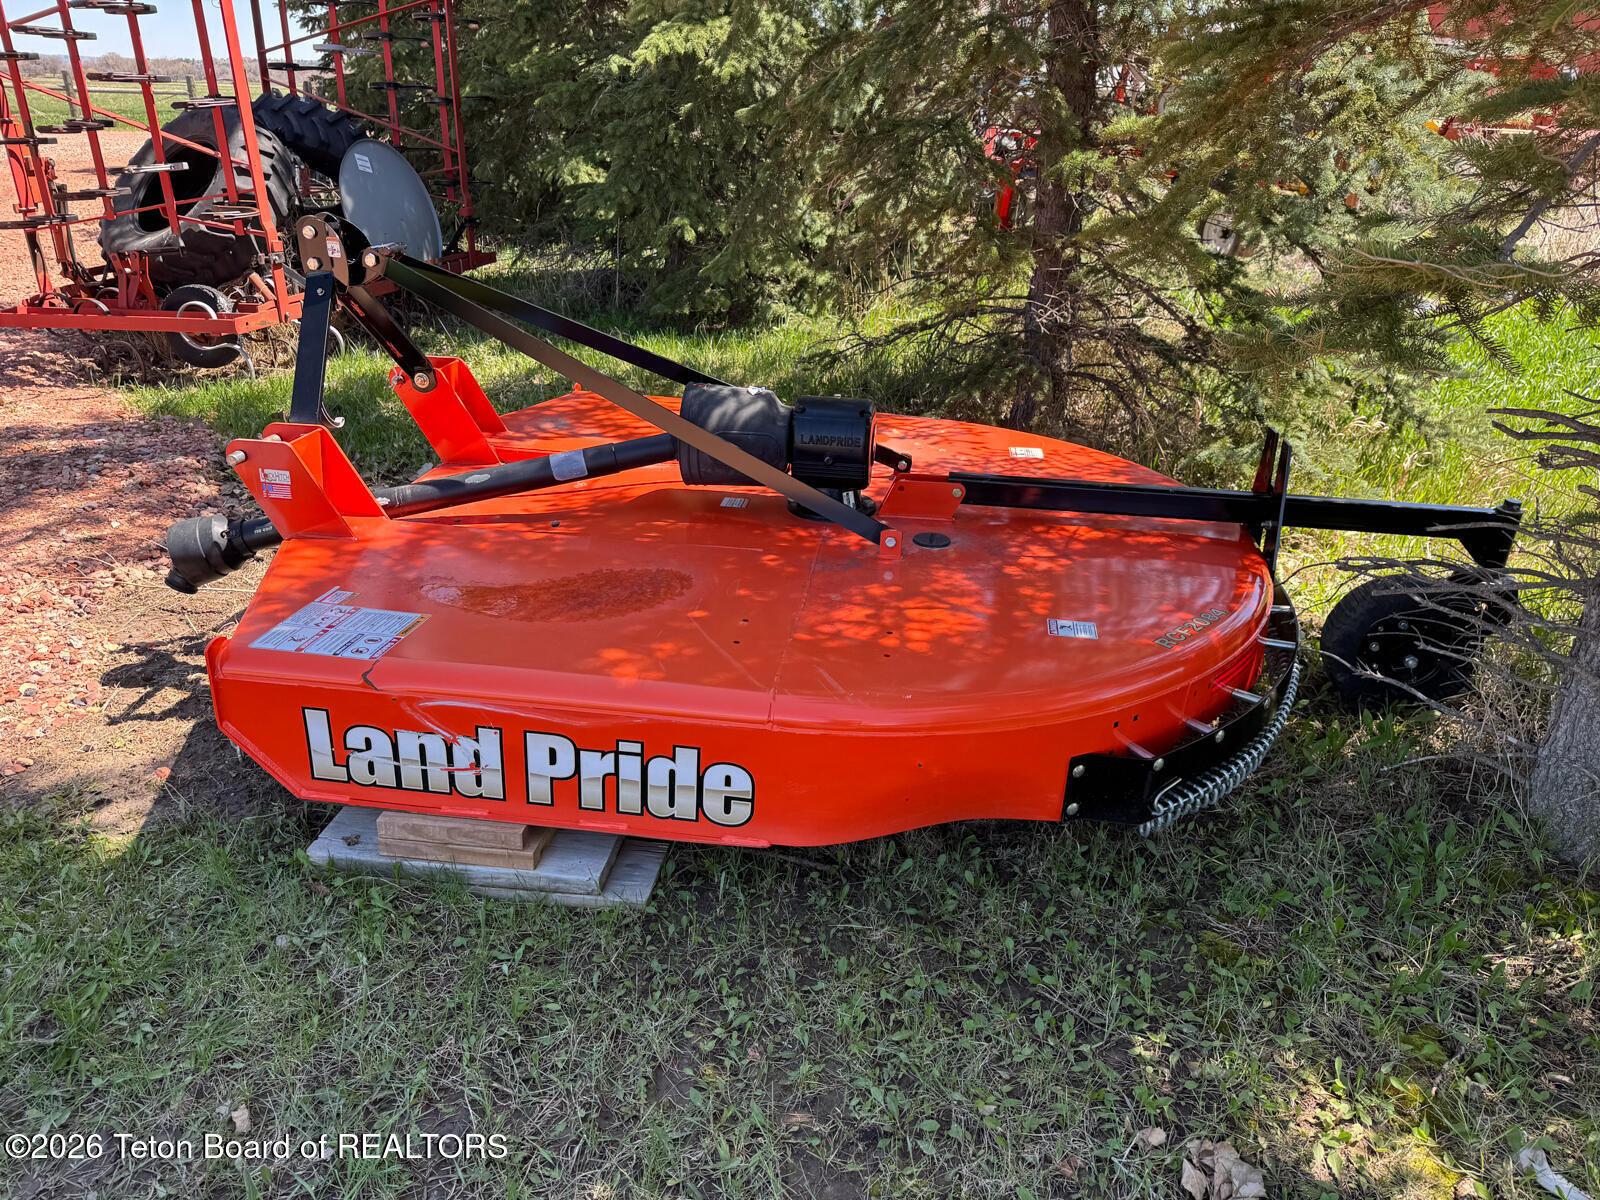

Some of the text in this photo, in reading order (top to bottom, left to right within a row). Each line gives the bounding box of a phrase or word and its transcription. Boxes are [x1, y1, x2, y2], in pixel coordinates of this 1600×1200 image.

[1153, 608, 1228, 648] RCF2084
[302, 707, 755, 828] Land Pride
